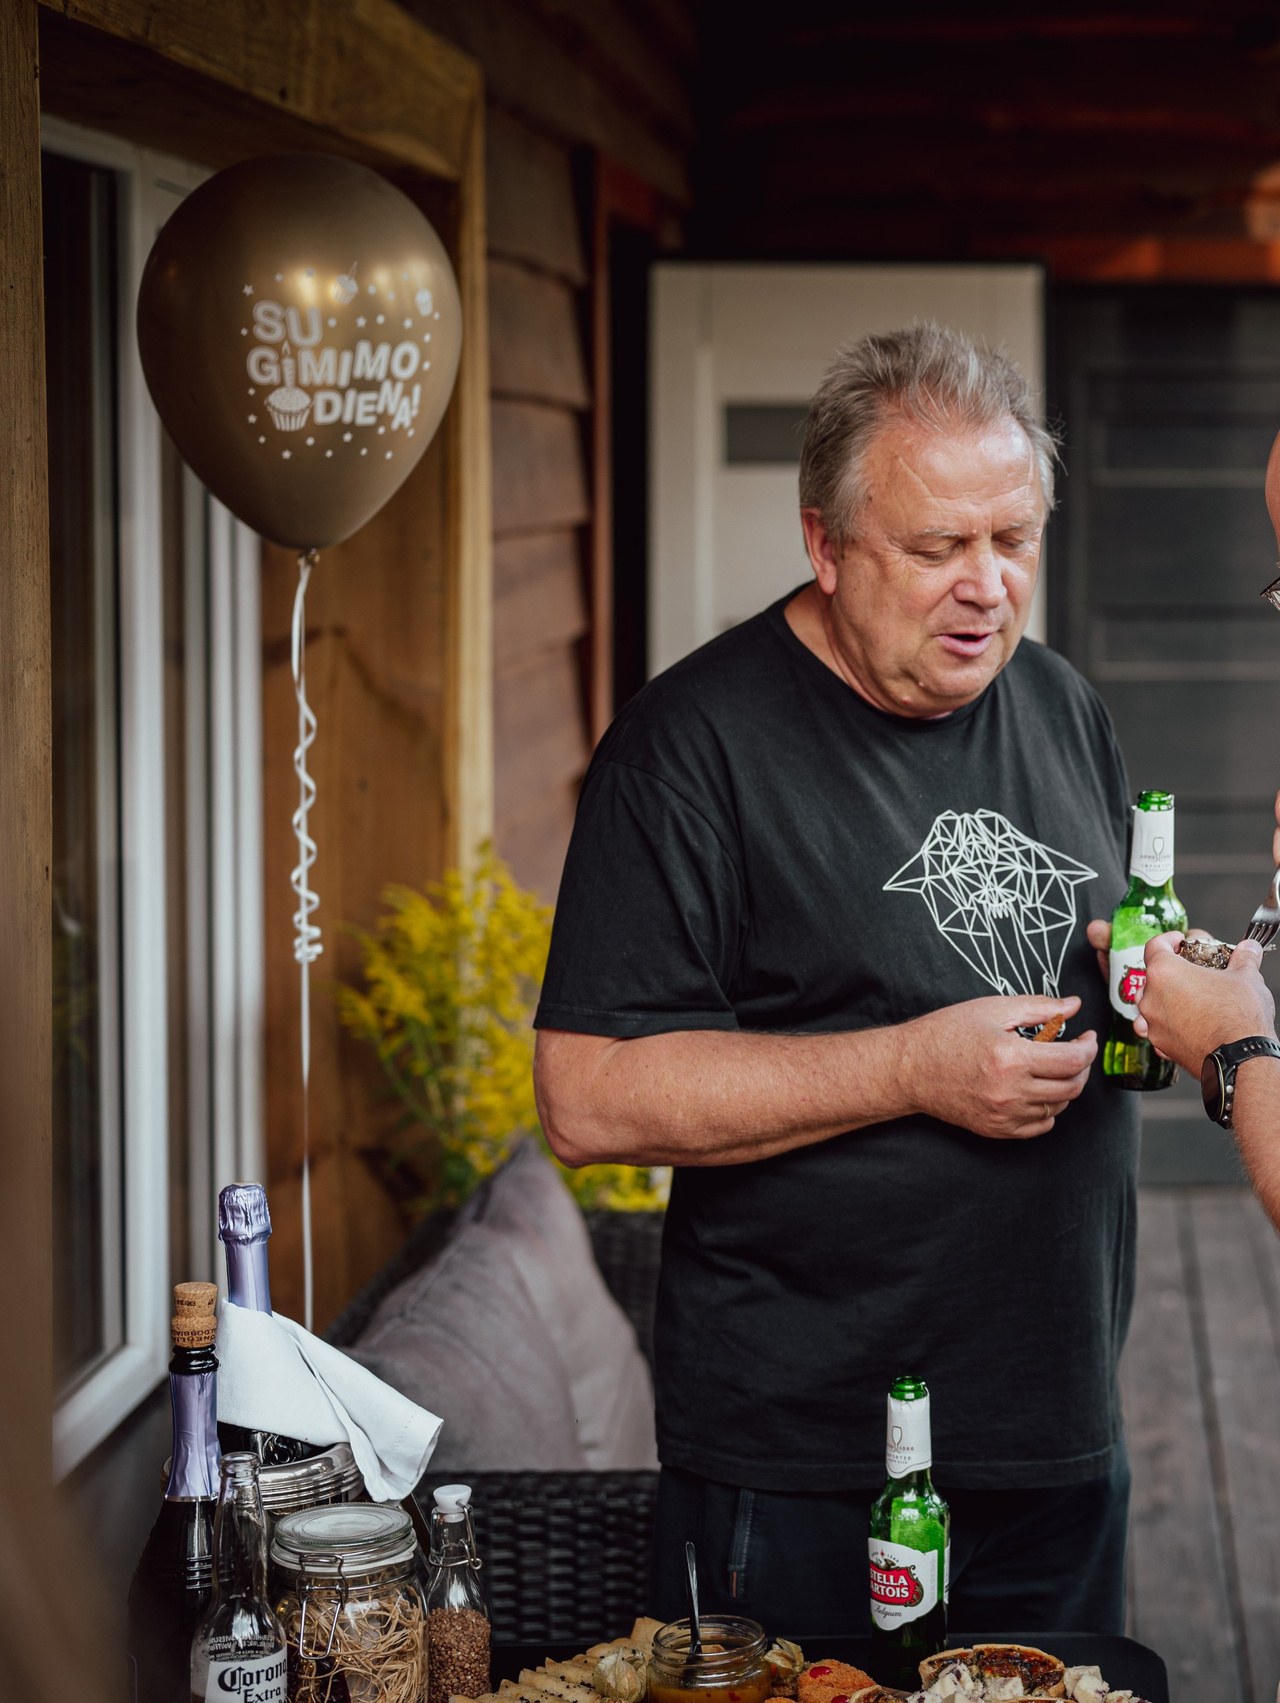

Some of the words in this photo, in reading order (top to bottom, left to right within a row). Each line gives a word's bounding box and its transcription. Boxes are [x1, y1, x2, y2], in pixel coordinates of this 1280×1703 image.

[253, 300, 322, 347] SU
[246, 340, 421, 388] GIMIMO
[314, 380, 421, 431] DIENA!
[870, 1568, 908, 1586] STELLA
[873, 1603, 902, 1618] Belgium
[218, 1659, 287, 1694] Corona
[244, 1687, 281, 1703] Extra
